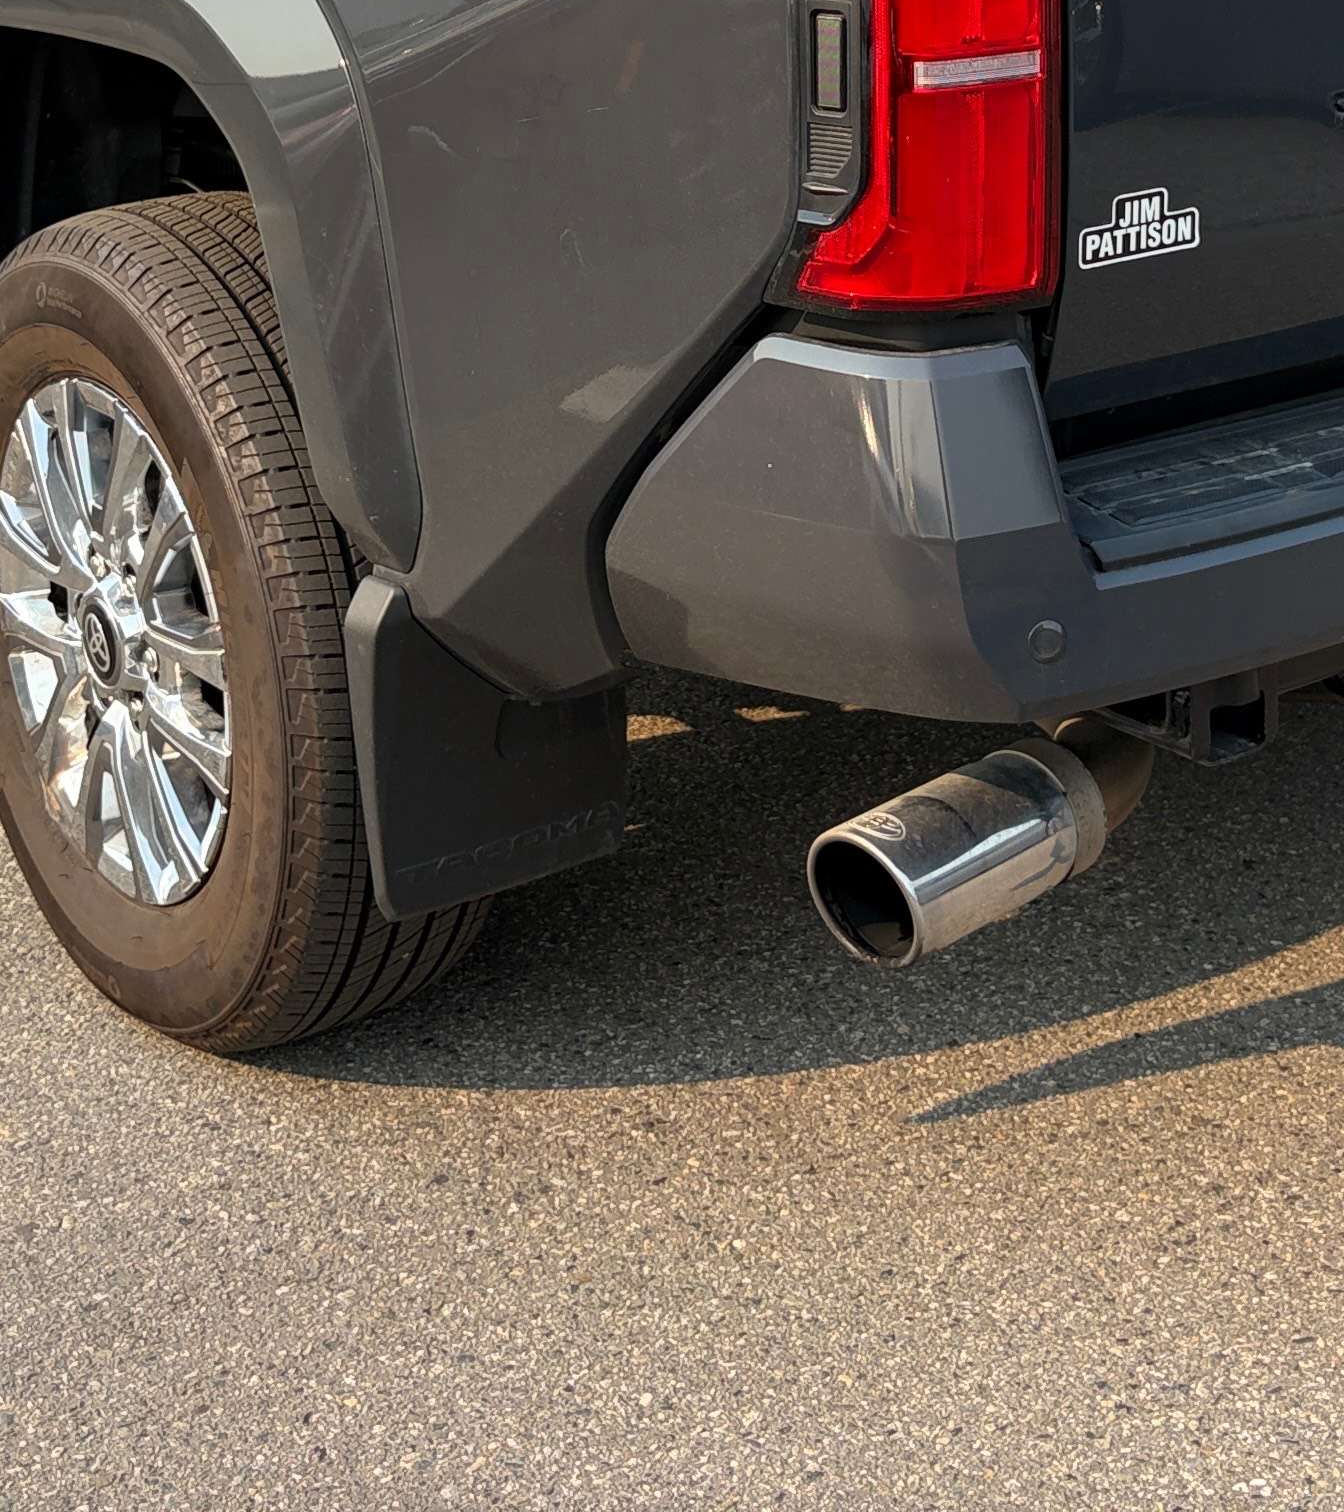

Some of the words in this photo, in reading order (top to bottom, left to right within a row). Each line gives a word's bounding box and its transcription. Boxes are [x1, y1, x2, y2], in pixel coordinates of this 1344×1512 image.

[1118, 195, 1161, 228] JIM
[1085, 214, 1193, 261] PATTISON
[395, 800, 622, 882] TACOMA
